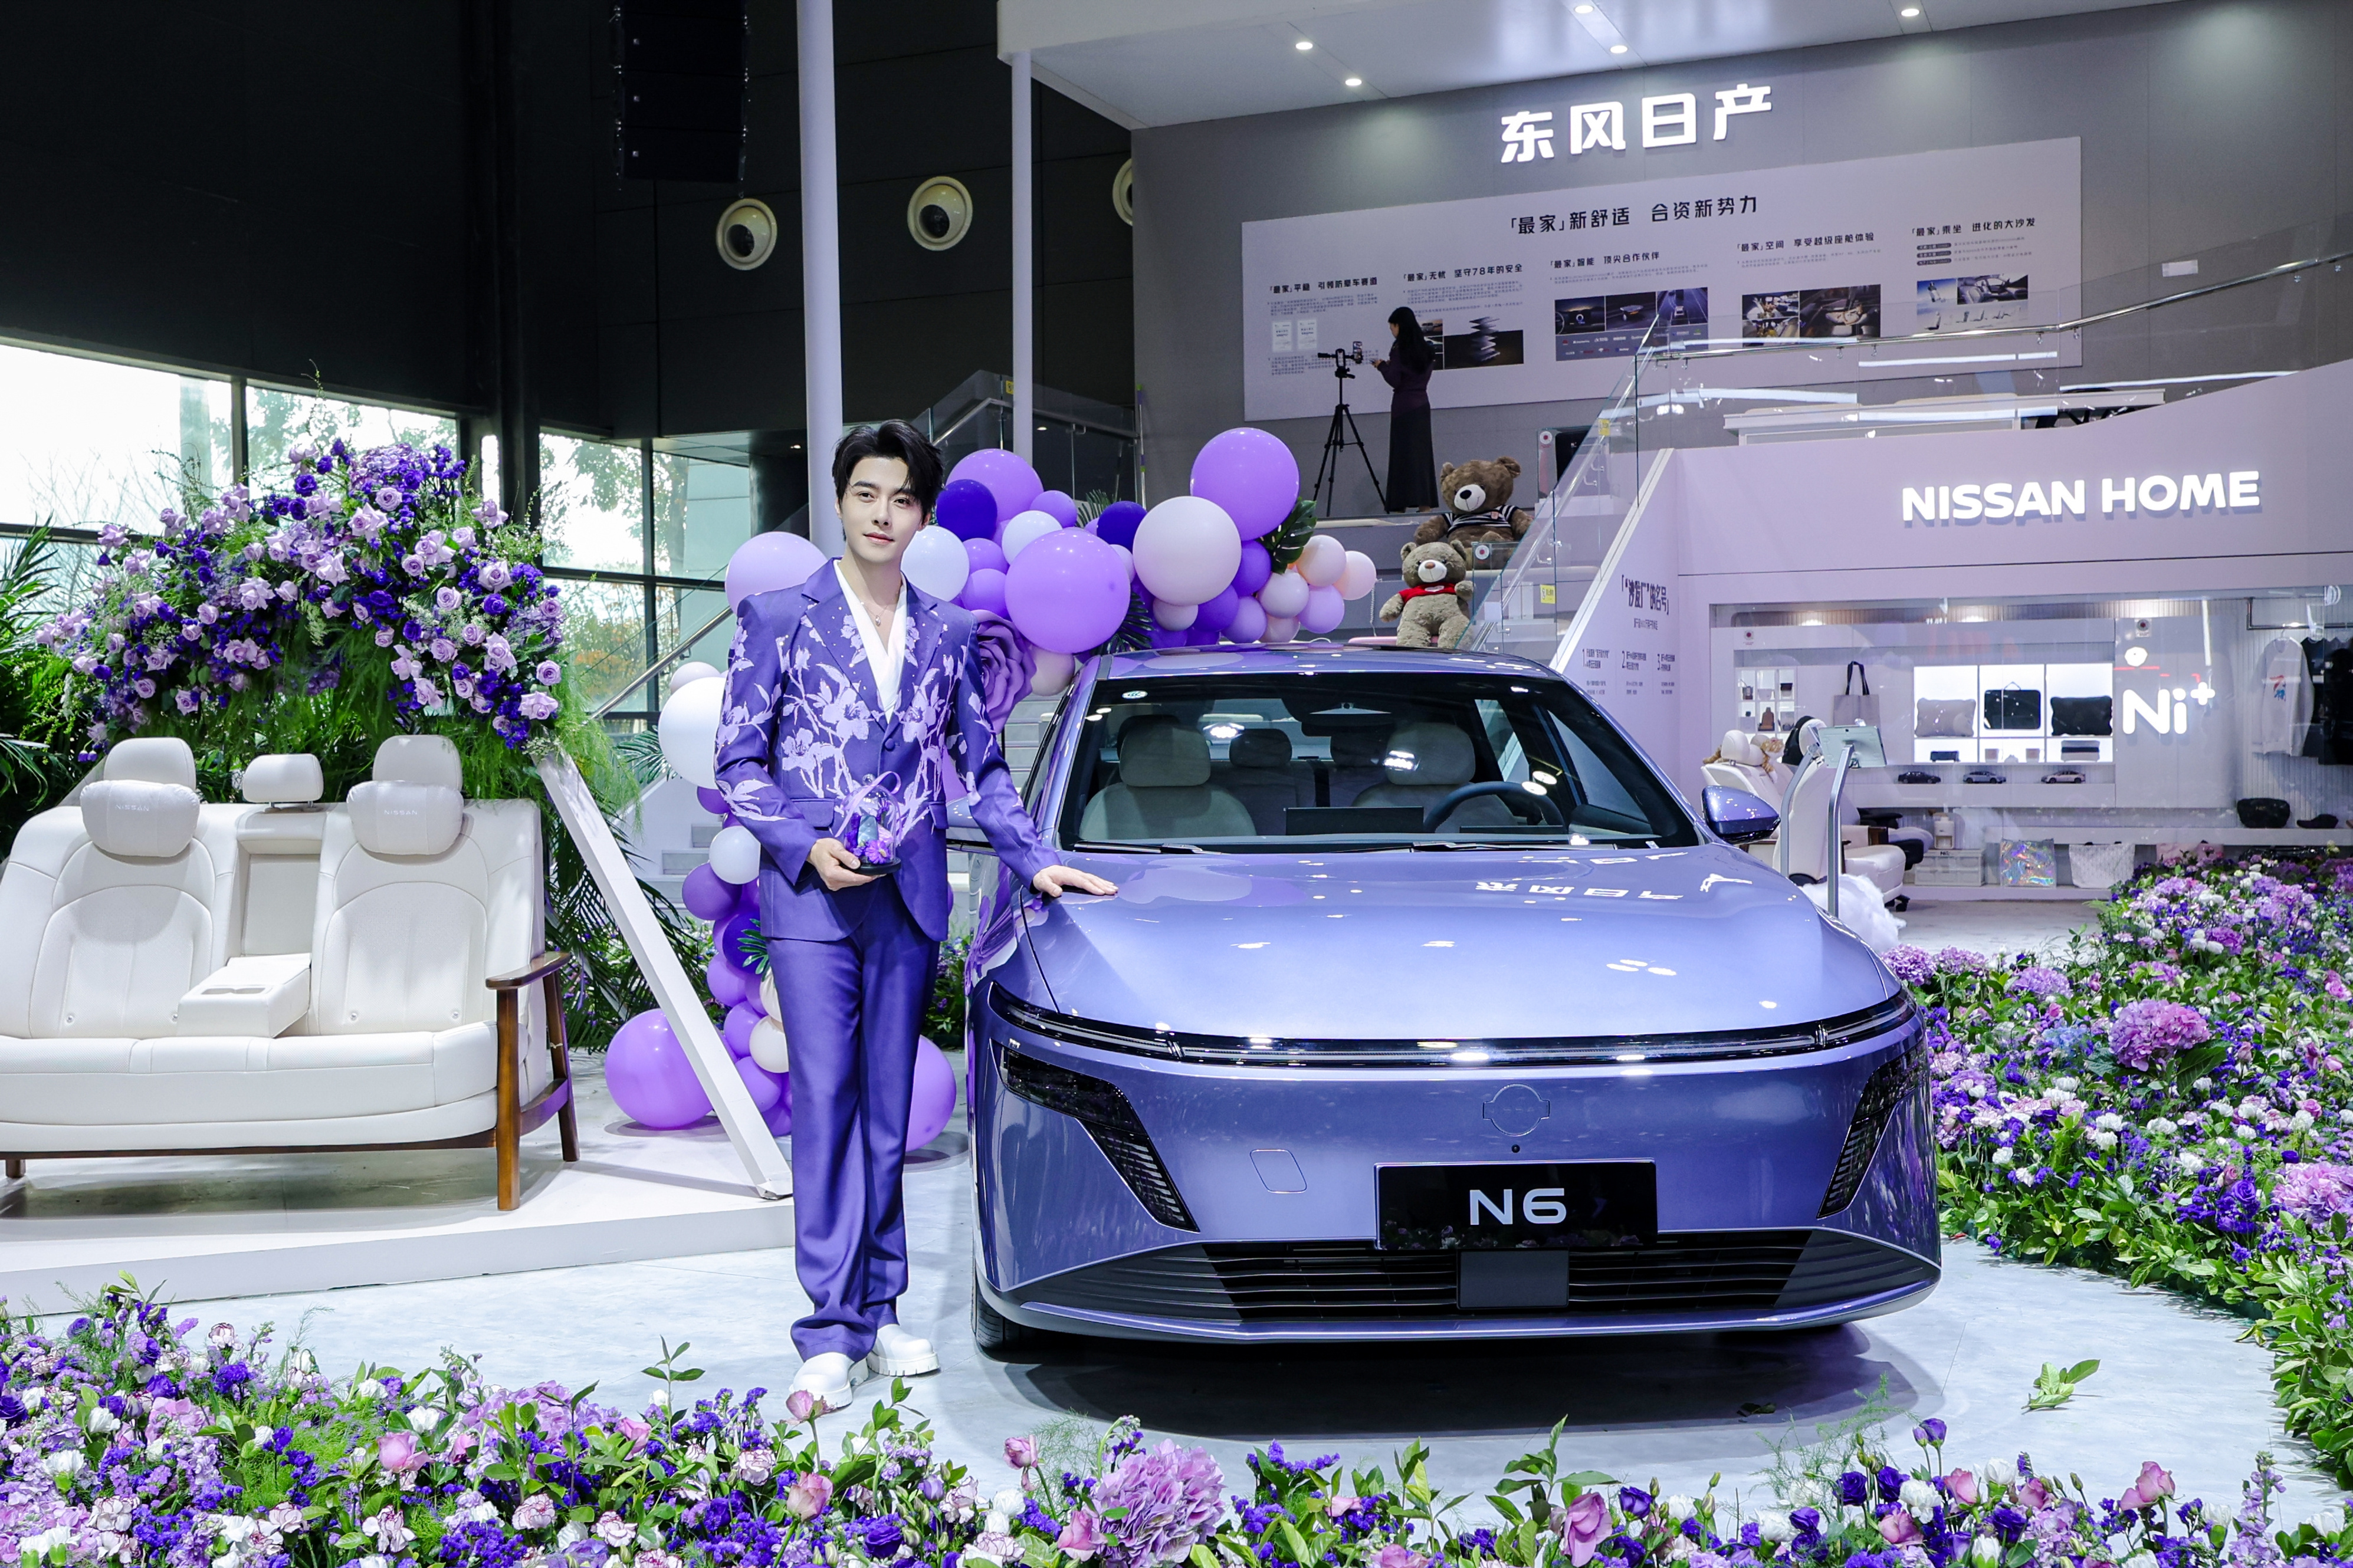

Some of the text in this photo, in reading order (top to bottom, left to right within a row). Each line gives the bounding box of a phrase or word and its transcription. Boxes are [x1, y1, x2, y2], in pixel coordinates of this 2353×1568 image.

[1501, 83, 1772, 163] 东风日产
[1511, 195, 1758, 235] 「最家」新舒适 合资新势力
[1972, 217, 2036, 232] 进化的大沙发
[1737, 232, 1875, 252] 「最家」空间 享受越级座舱体验
[1550, 251, 1660, 269] 「最家」智能 顶尖合作伙伴
[1454, 264, 1523, 278] 坚守78年的安全
[1902, 470, 2260, 521] NISSAN HOME
[116, 804, 150, 812] NISSAN
[1469, 1188, 1567, 1225] N6
